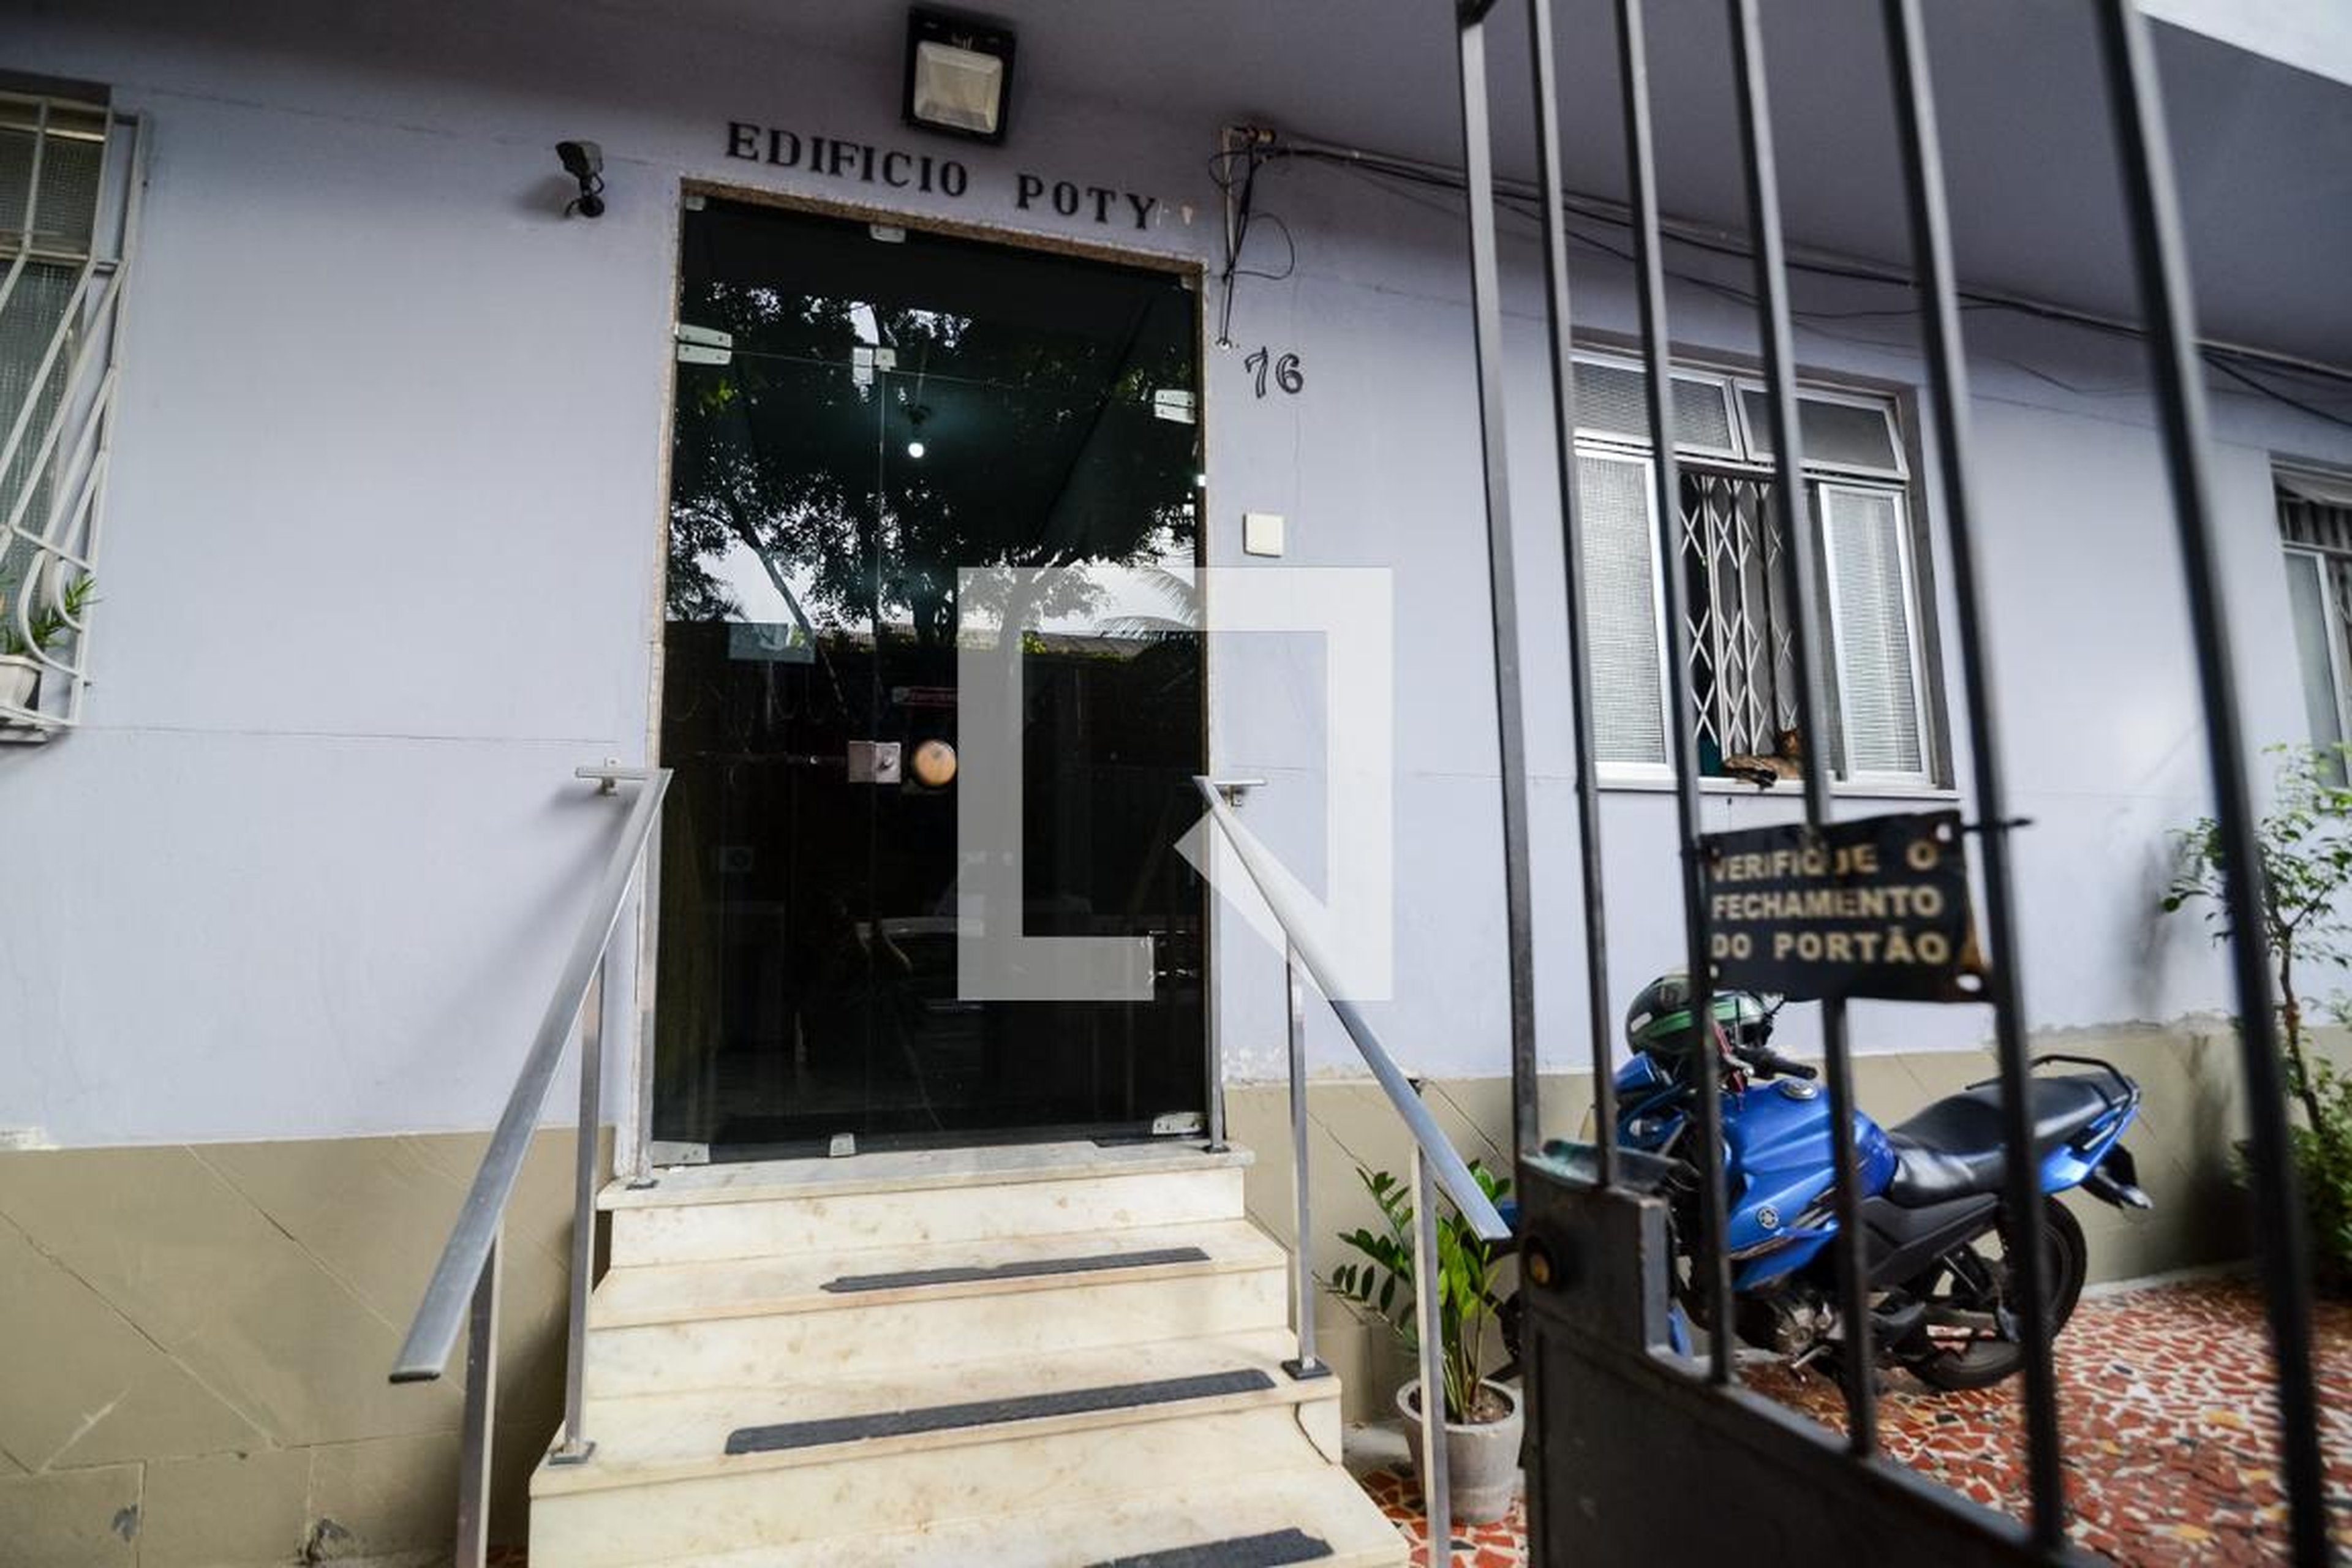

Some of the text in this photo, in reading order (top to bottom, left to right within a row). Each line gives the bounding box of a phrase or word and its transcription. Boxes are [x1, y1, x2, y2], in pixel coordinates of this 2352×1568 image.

[726, 123, 1156, 230] EDIFICIO POTY
[1245, 345, 1303, 399] 76
[1907, 841, 1938, 872] O
[1712, 886, 1943, 920] FECHAMENTO
[1712, 926, 1949, 963] DO PORTÃO
